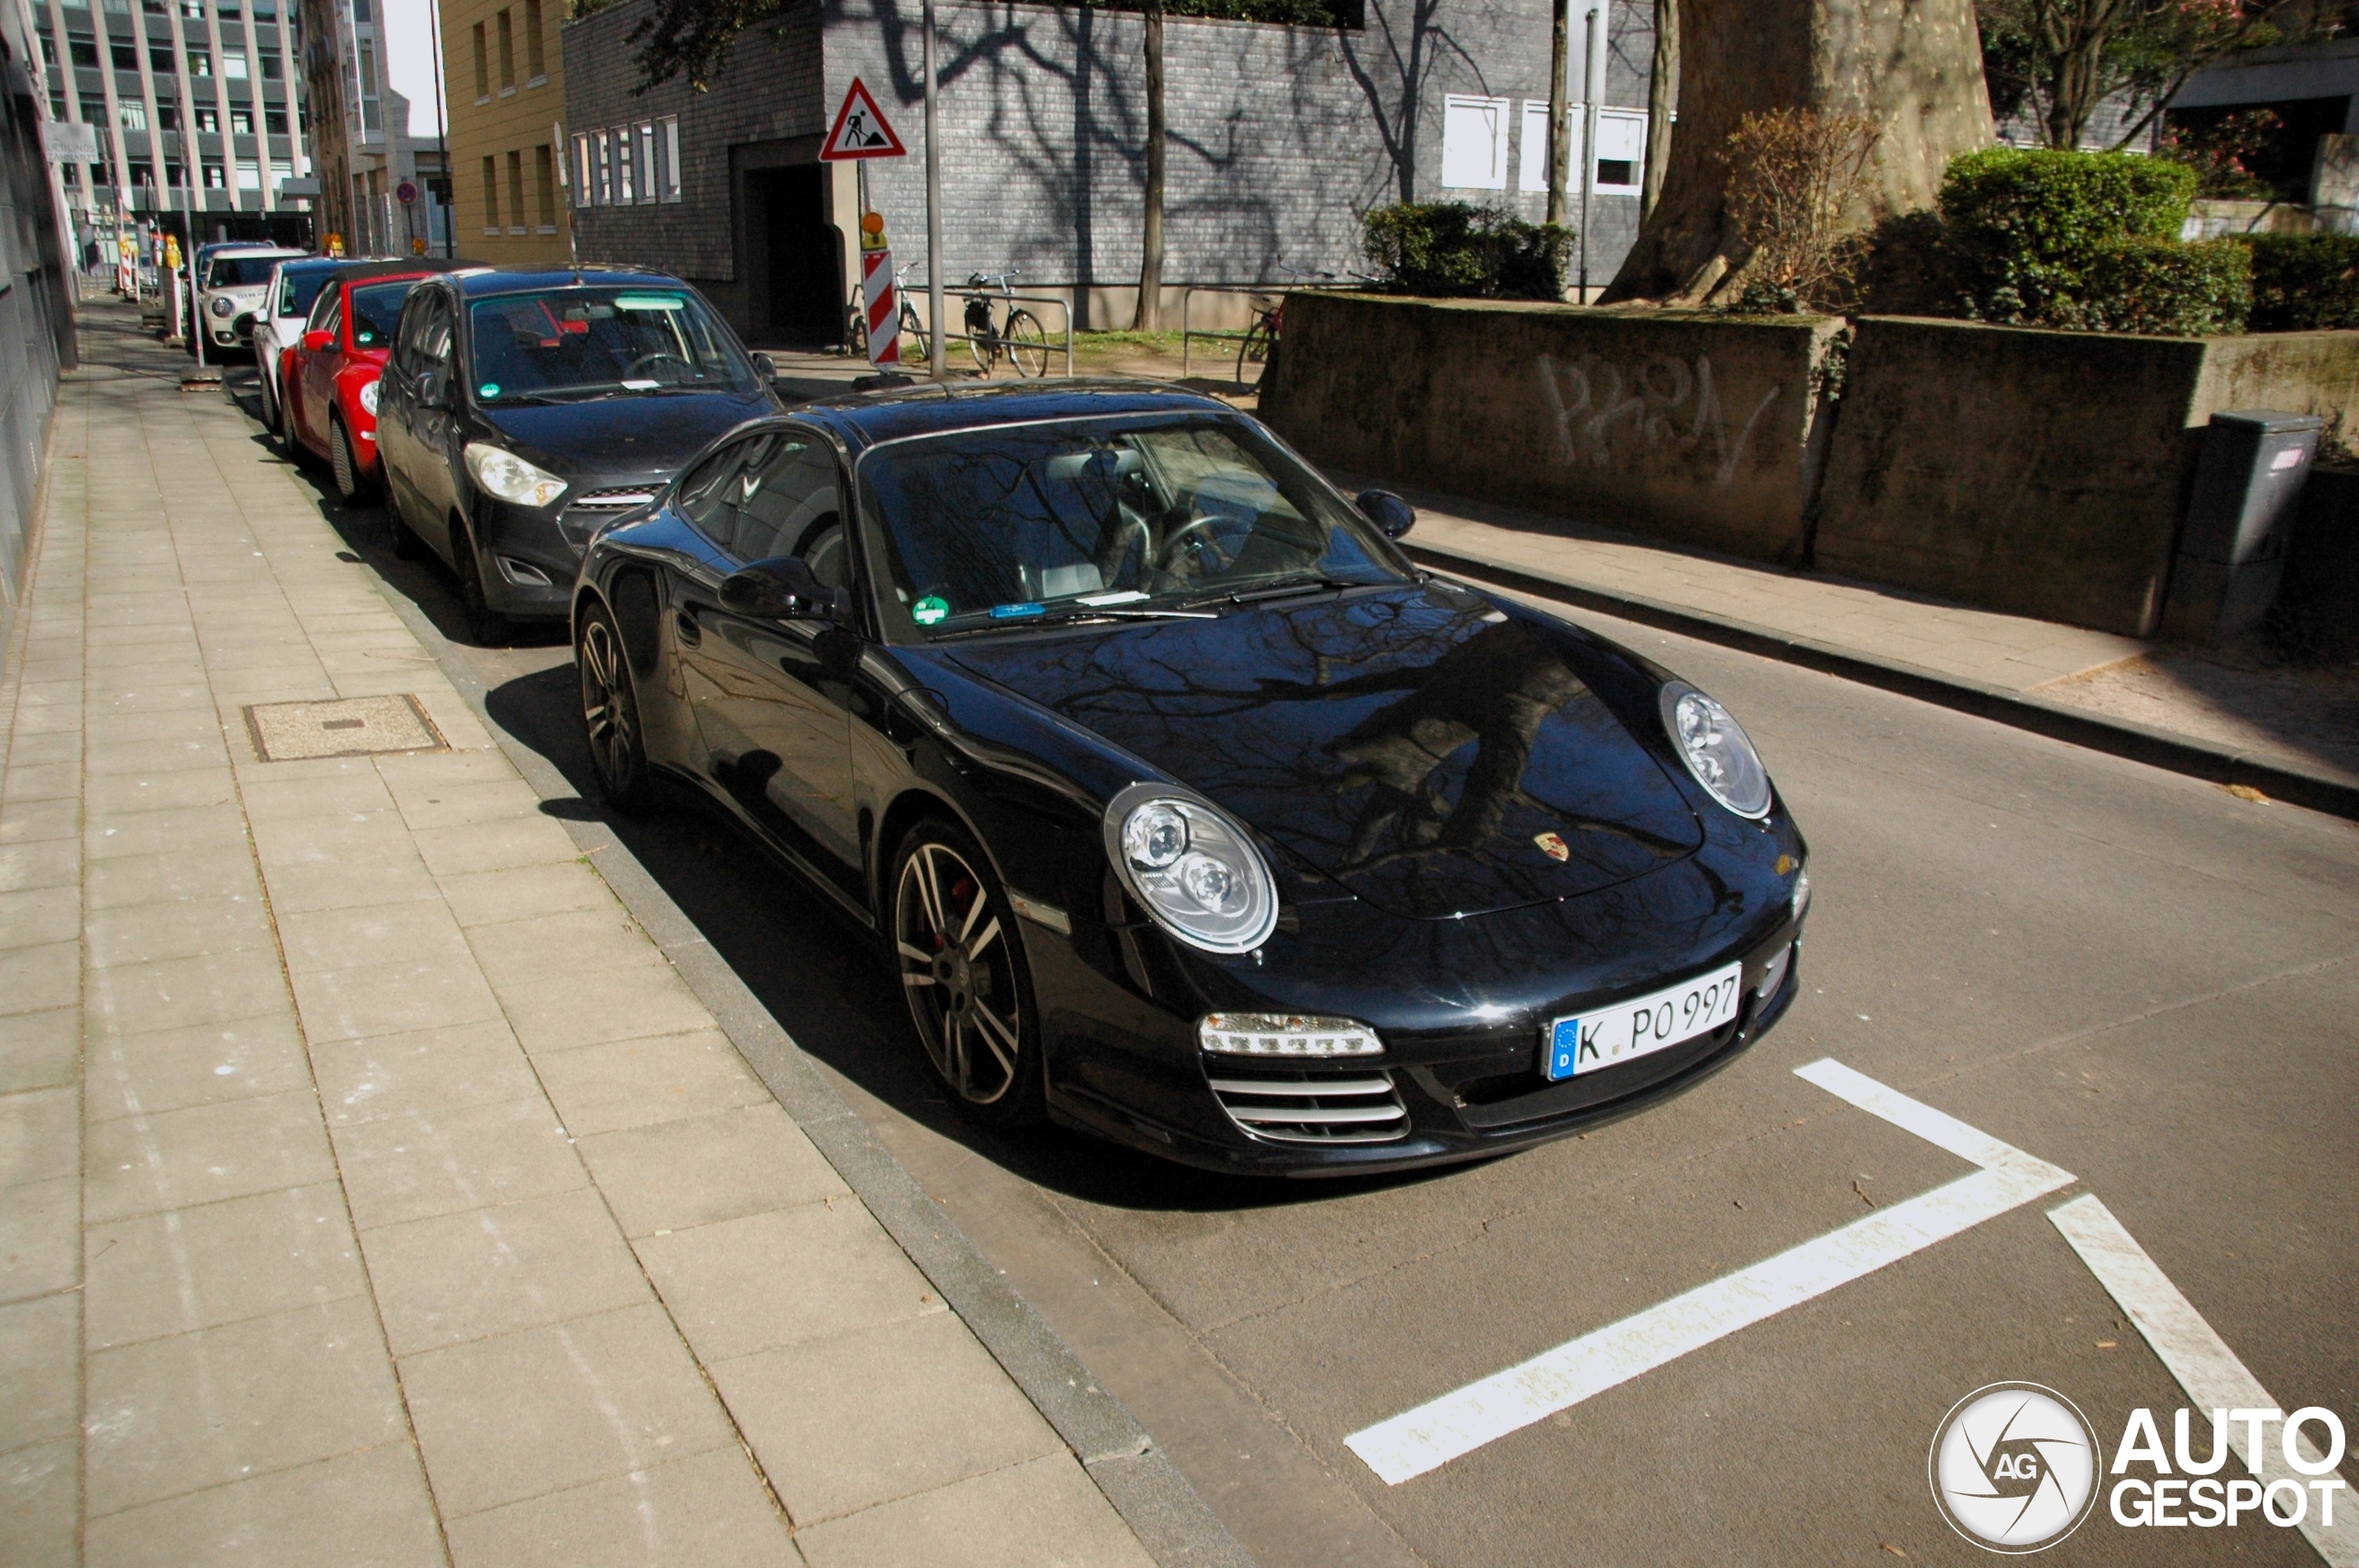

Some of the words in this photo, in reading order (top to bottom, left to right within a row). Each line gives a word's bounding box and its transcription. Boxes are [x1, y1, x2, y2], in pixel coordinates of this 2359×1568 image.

[1579, 1021, 1603, 1064] K
[1632, 1001, 1673, 1049] PO
[1684, 975, 1737, 1031] 997
[1559, 1054, 1569, 1067] D
